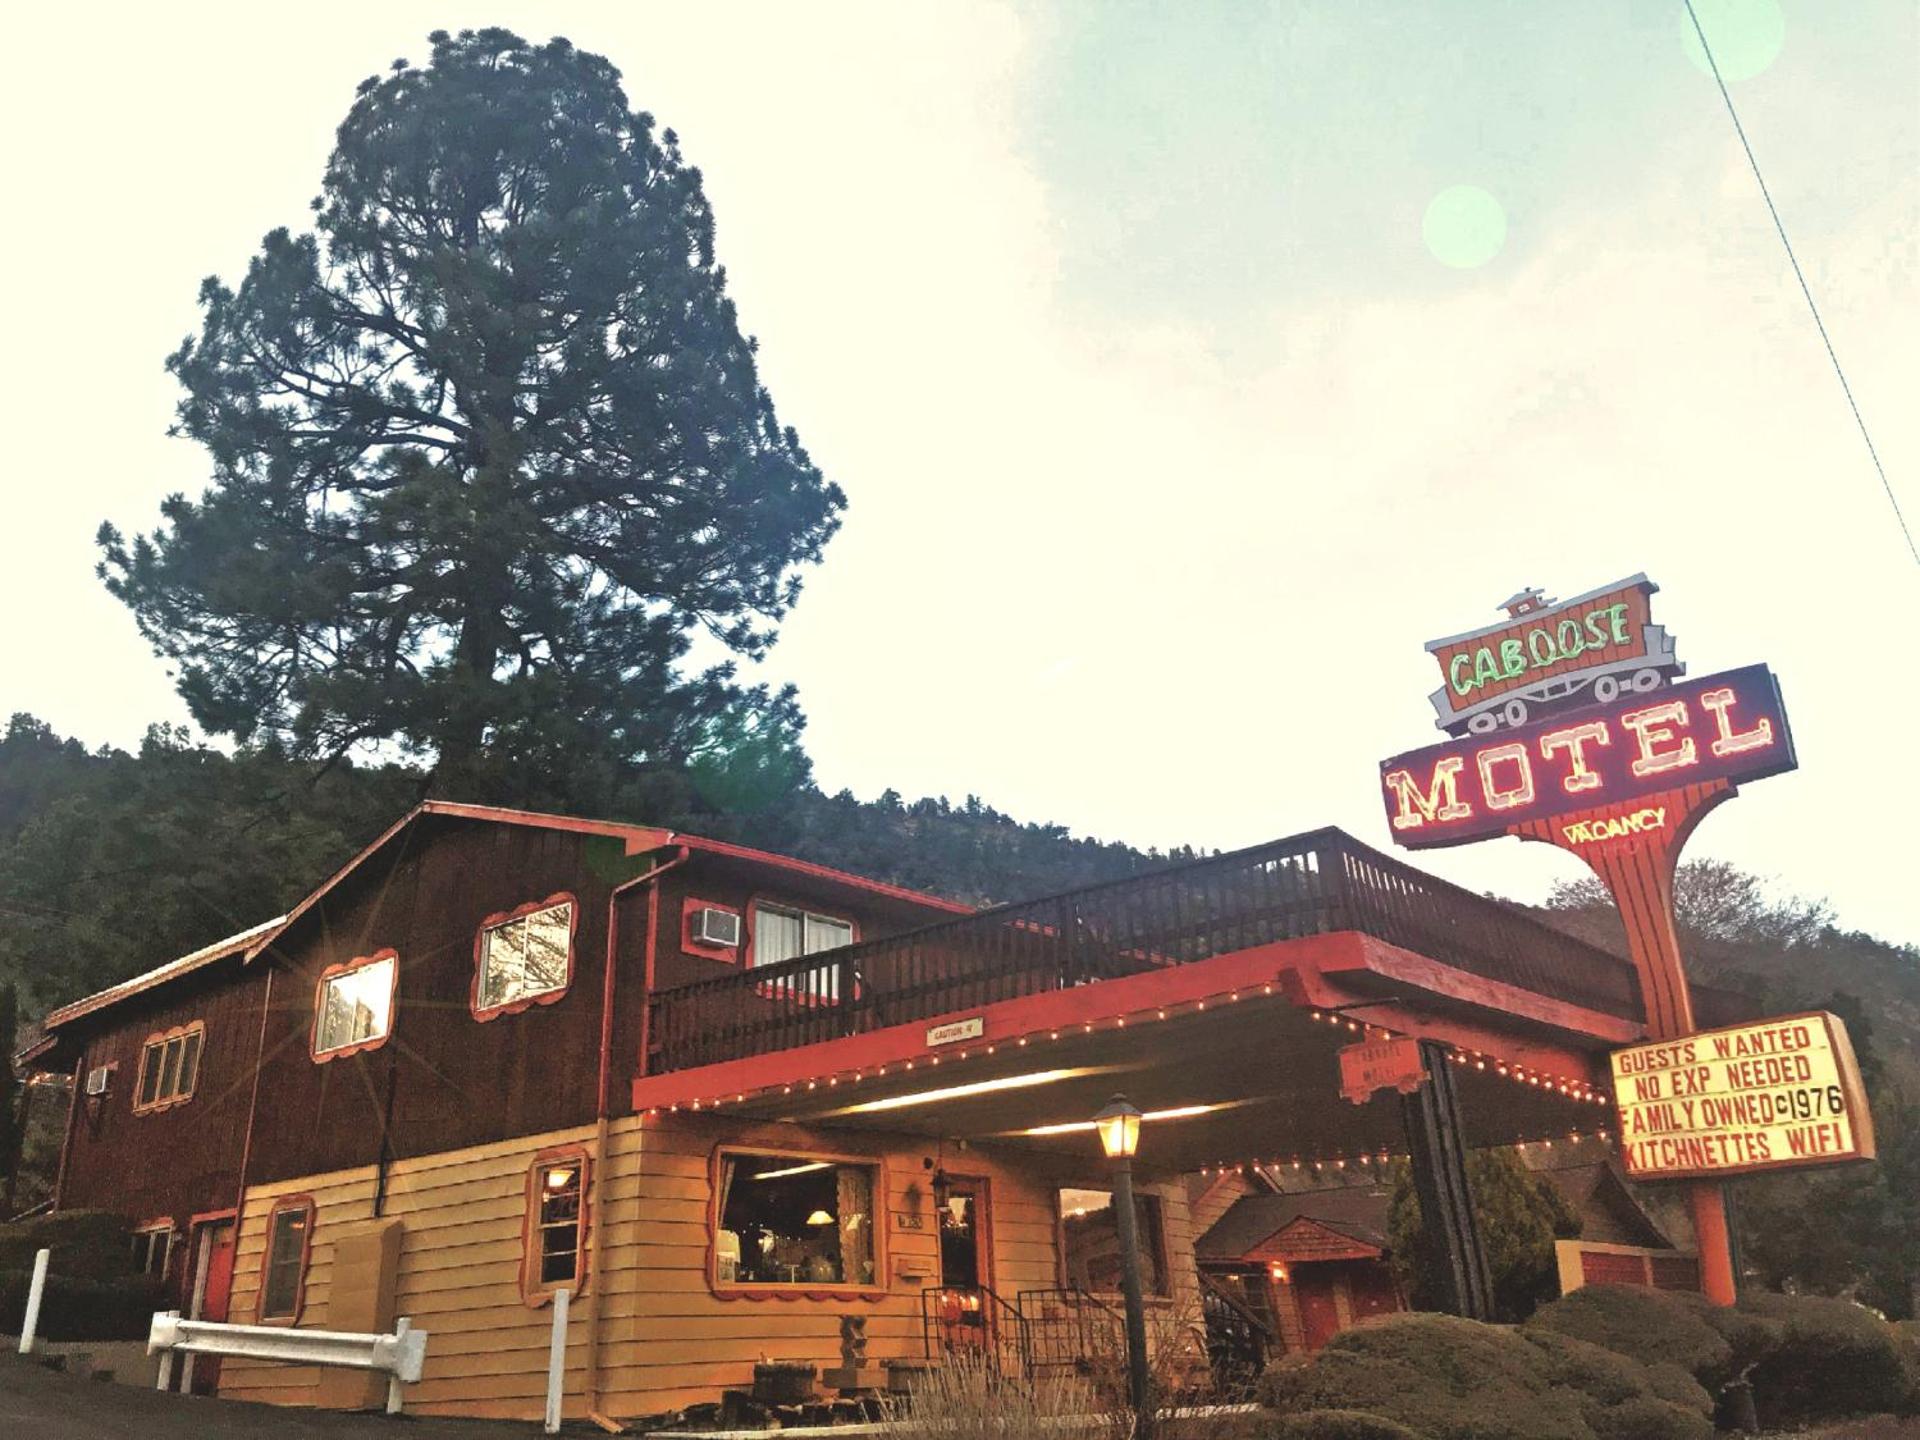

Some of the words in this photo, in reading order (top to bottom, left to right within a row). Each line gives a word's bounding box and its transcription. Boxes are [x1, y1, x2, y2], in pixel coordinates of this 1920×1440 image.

[1450, 603, 1634, 696] CABOOSE
[1385, 688, 1772, 831] MOTEL
[1561, 807, 1666, 845] VACANCY
[1620, 1042, 1697, 1074] GUESTS
[1712, 1025, 1812, 1058] WANTED
[1634, 1075, 1661, 1101] NO
[1671, 1066, 1711, 1094] EXP
[1727, 1055, 1812, 1090] NEEDED
[1619, 1097, 1695, 1135] FAMILY
[1701, 1093, 1774, 1128] OWNED
[1624, 1131, 1771, 1170] KITCHNETTES
[1786, 1122, 1845, 1156] WIFI
